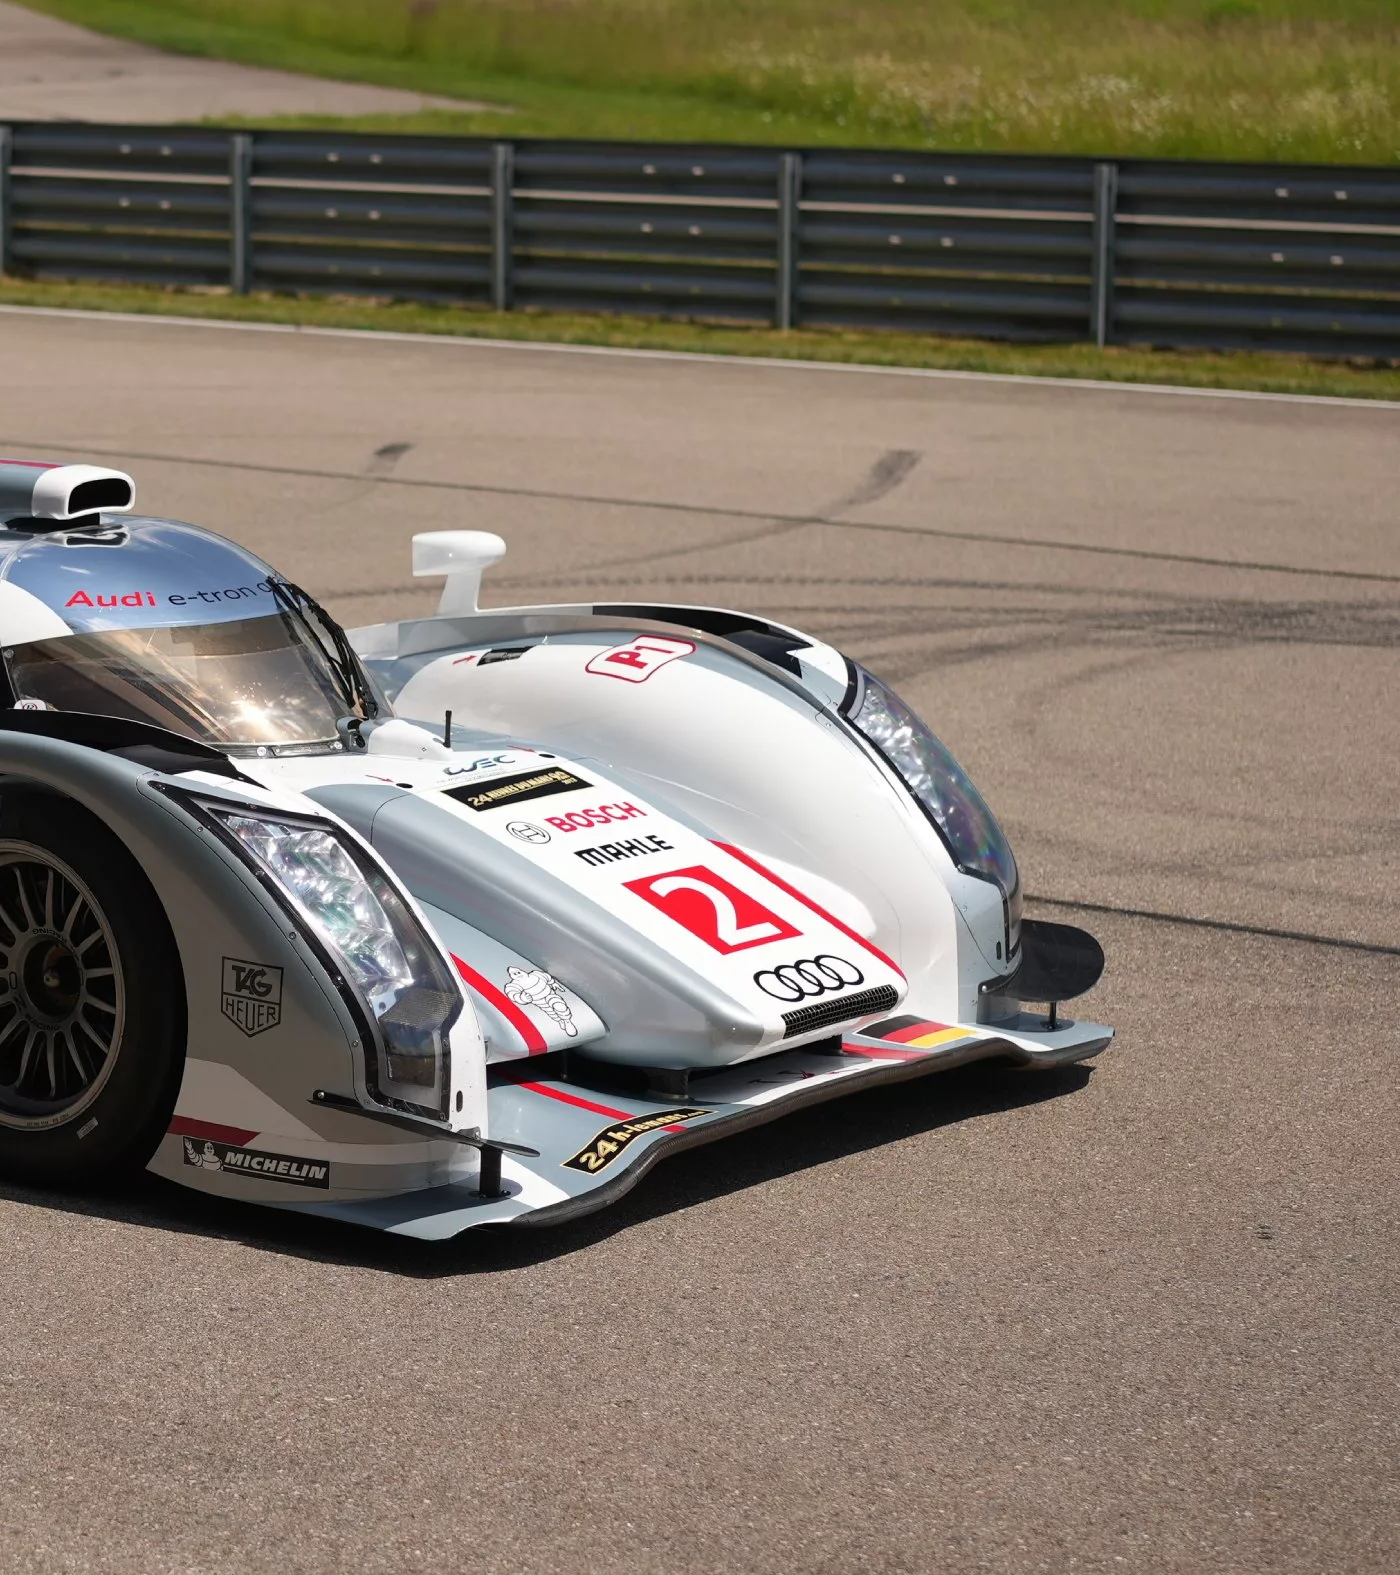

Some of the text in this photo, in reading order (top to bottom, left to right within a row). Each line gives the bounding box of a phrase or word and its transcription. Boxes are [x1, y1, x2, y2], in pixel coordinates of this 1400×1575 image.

[65, 590, 156, 608] Audi
[168, 586, 257, 606] e-tron
[604, 637, 677, 673] P1
[443, 754, 516, 776] WEC
[467, 793, 493, 807] 24
[544, 801, 647, 834] BOSCH
[573, 834, 674, 867] MAHLE
[648, 875, 784, 949] 2
[231, 964, 273, 998] TAG
[225, 998, 278, 1031] HEUER
[225, 1151, 327, 1180] MICHELIN
